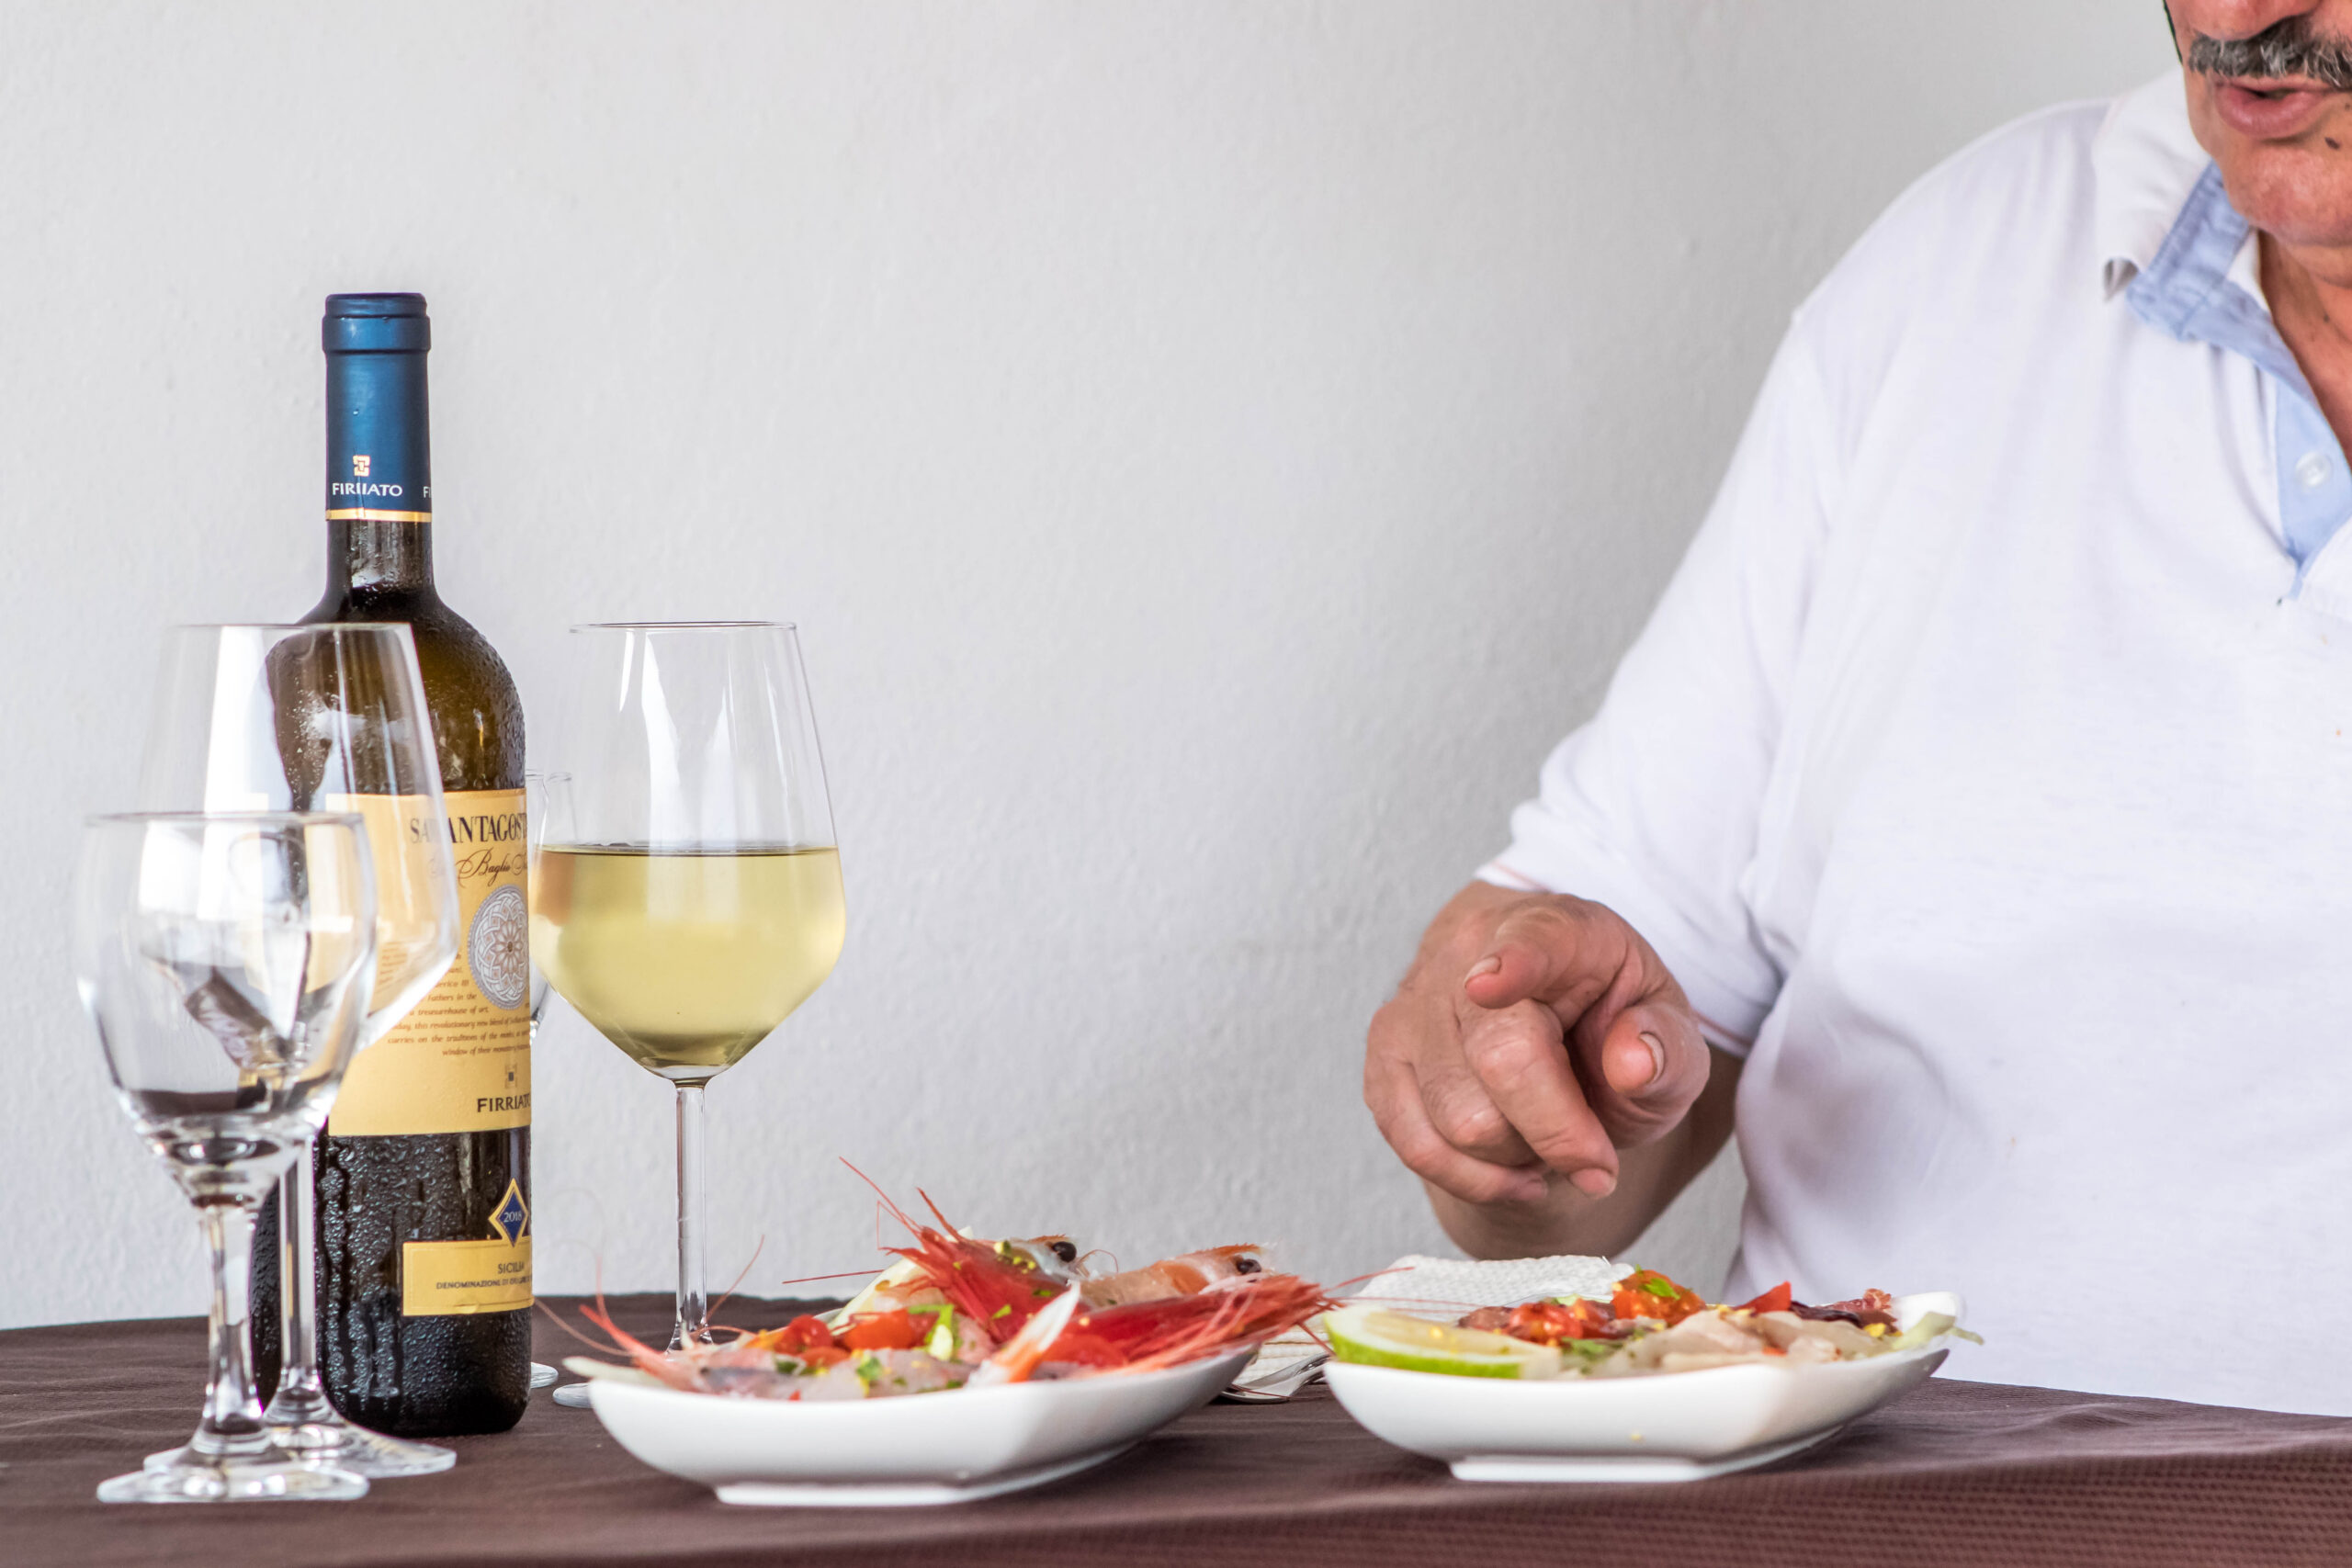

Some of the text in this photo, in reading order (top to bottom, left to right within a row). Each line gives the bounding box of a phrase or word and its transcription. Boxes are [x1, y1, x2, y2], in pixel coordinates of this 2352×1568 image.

[466, 992, 477, 1000] the
[469, 1006, 477, 1016] of
[388, 1036, 413, 1044] carries
[432, 1034, 442, 1043] the
[480, 1032, 487, 1043] of
[442, 1047, 467, 1056] window
[469, 1045, 477, 1056] of
[503, 1211, 522, 1224] 2018
